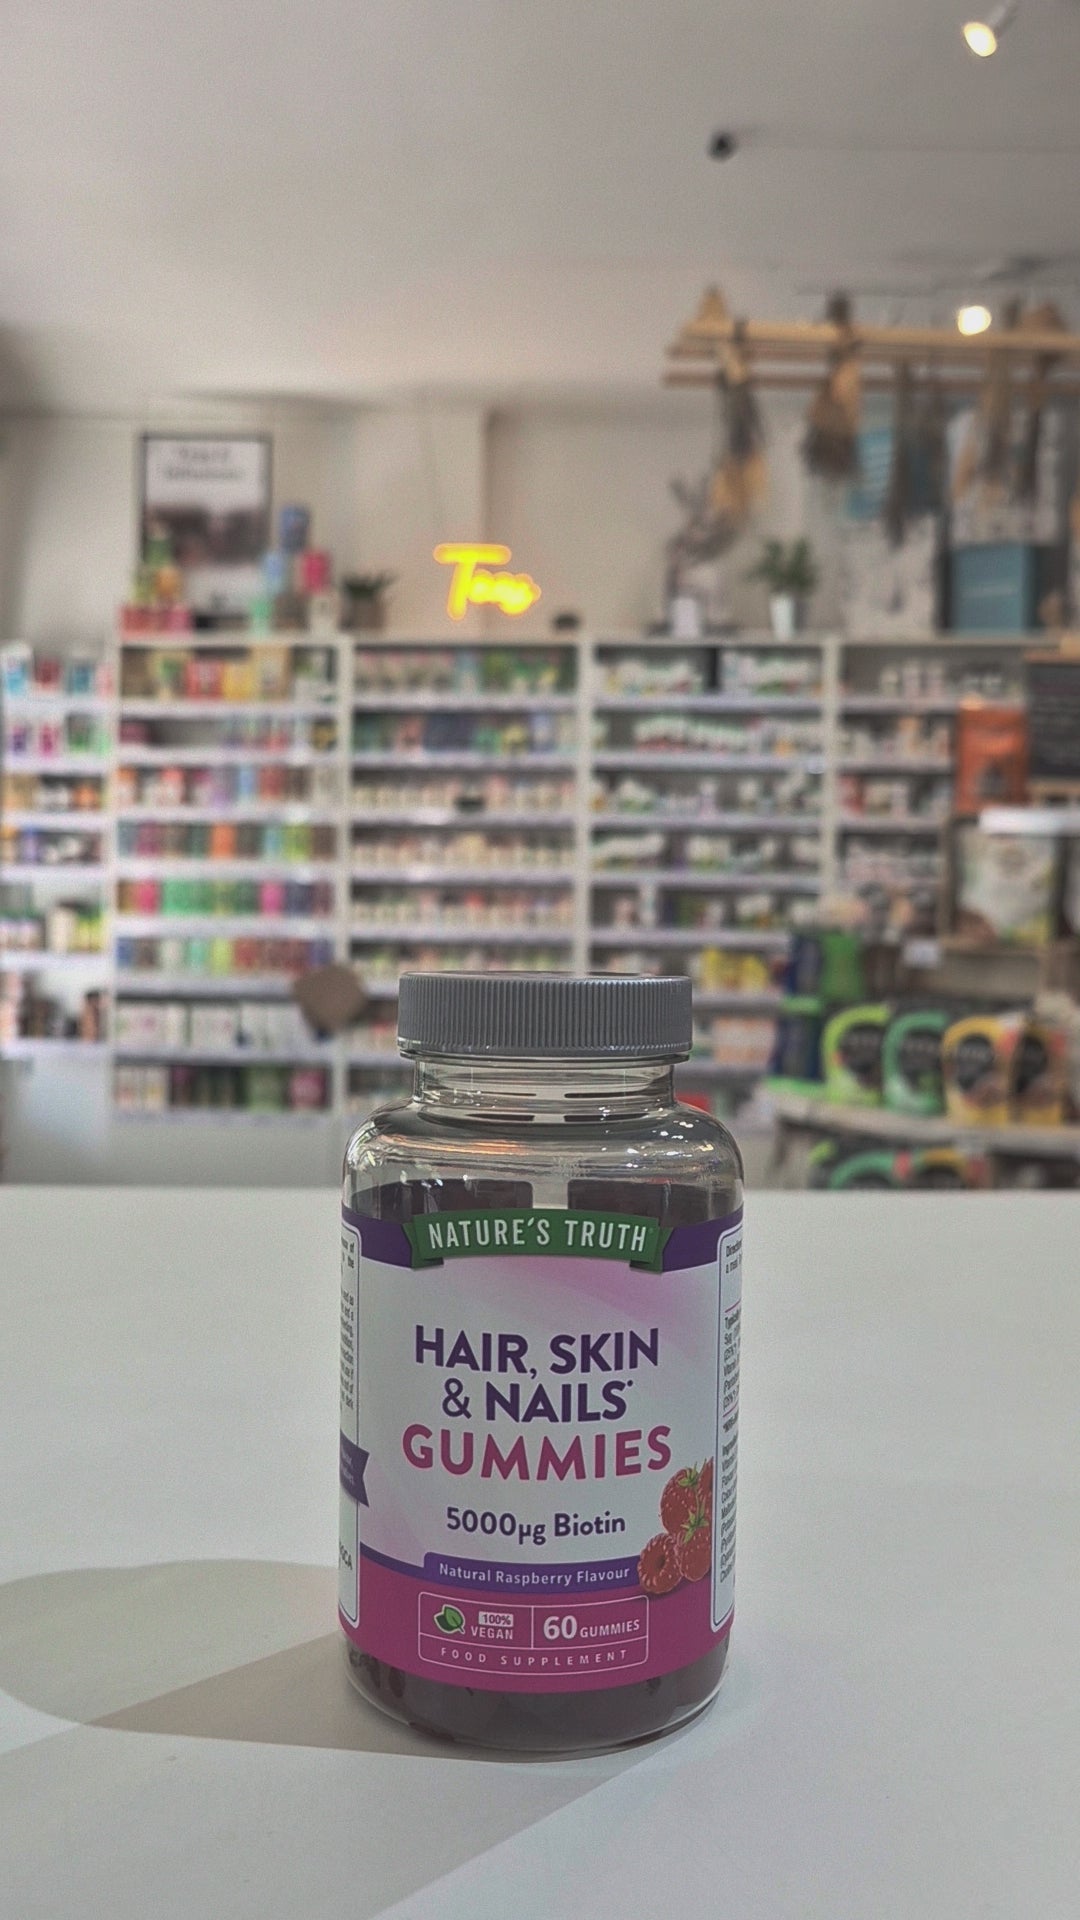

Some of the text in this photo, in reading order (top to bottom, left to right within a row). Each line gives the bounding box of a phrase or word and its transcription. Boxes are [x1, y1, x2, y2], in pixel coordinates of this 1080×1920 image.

[428, 1217, 647, 1252] NATURE'S TRUTH
[415, 1324, 659, 1378] HAIR, SKIN
[441, 1377, 471, 1419] &
[402, 1423, 672, 1482] GUMMIES
[446, 1506, 626, 1545] 5000µg Biotin
[439, 1562, 630, 1587] Natural Raspberry Flavour
[470, 1625, 514, 1641] VEGAN
[481, 1612, 513, 1626] 100%
[543, 1615, 641, 1641] 60 GUMMIES
[440, 1647, 628, 1667] FOOD SUPPLEMENT
